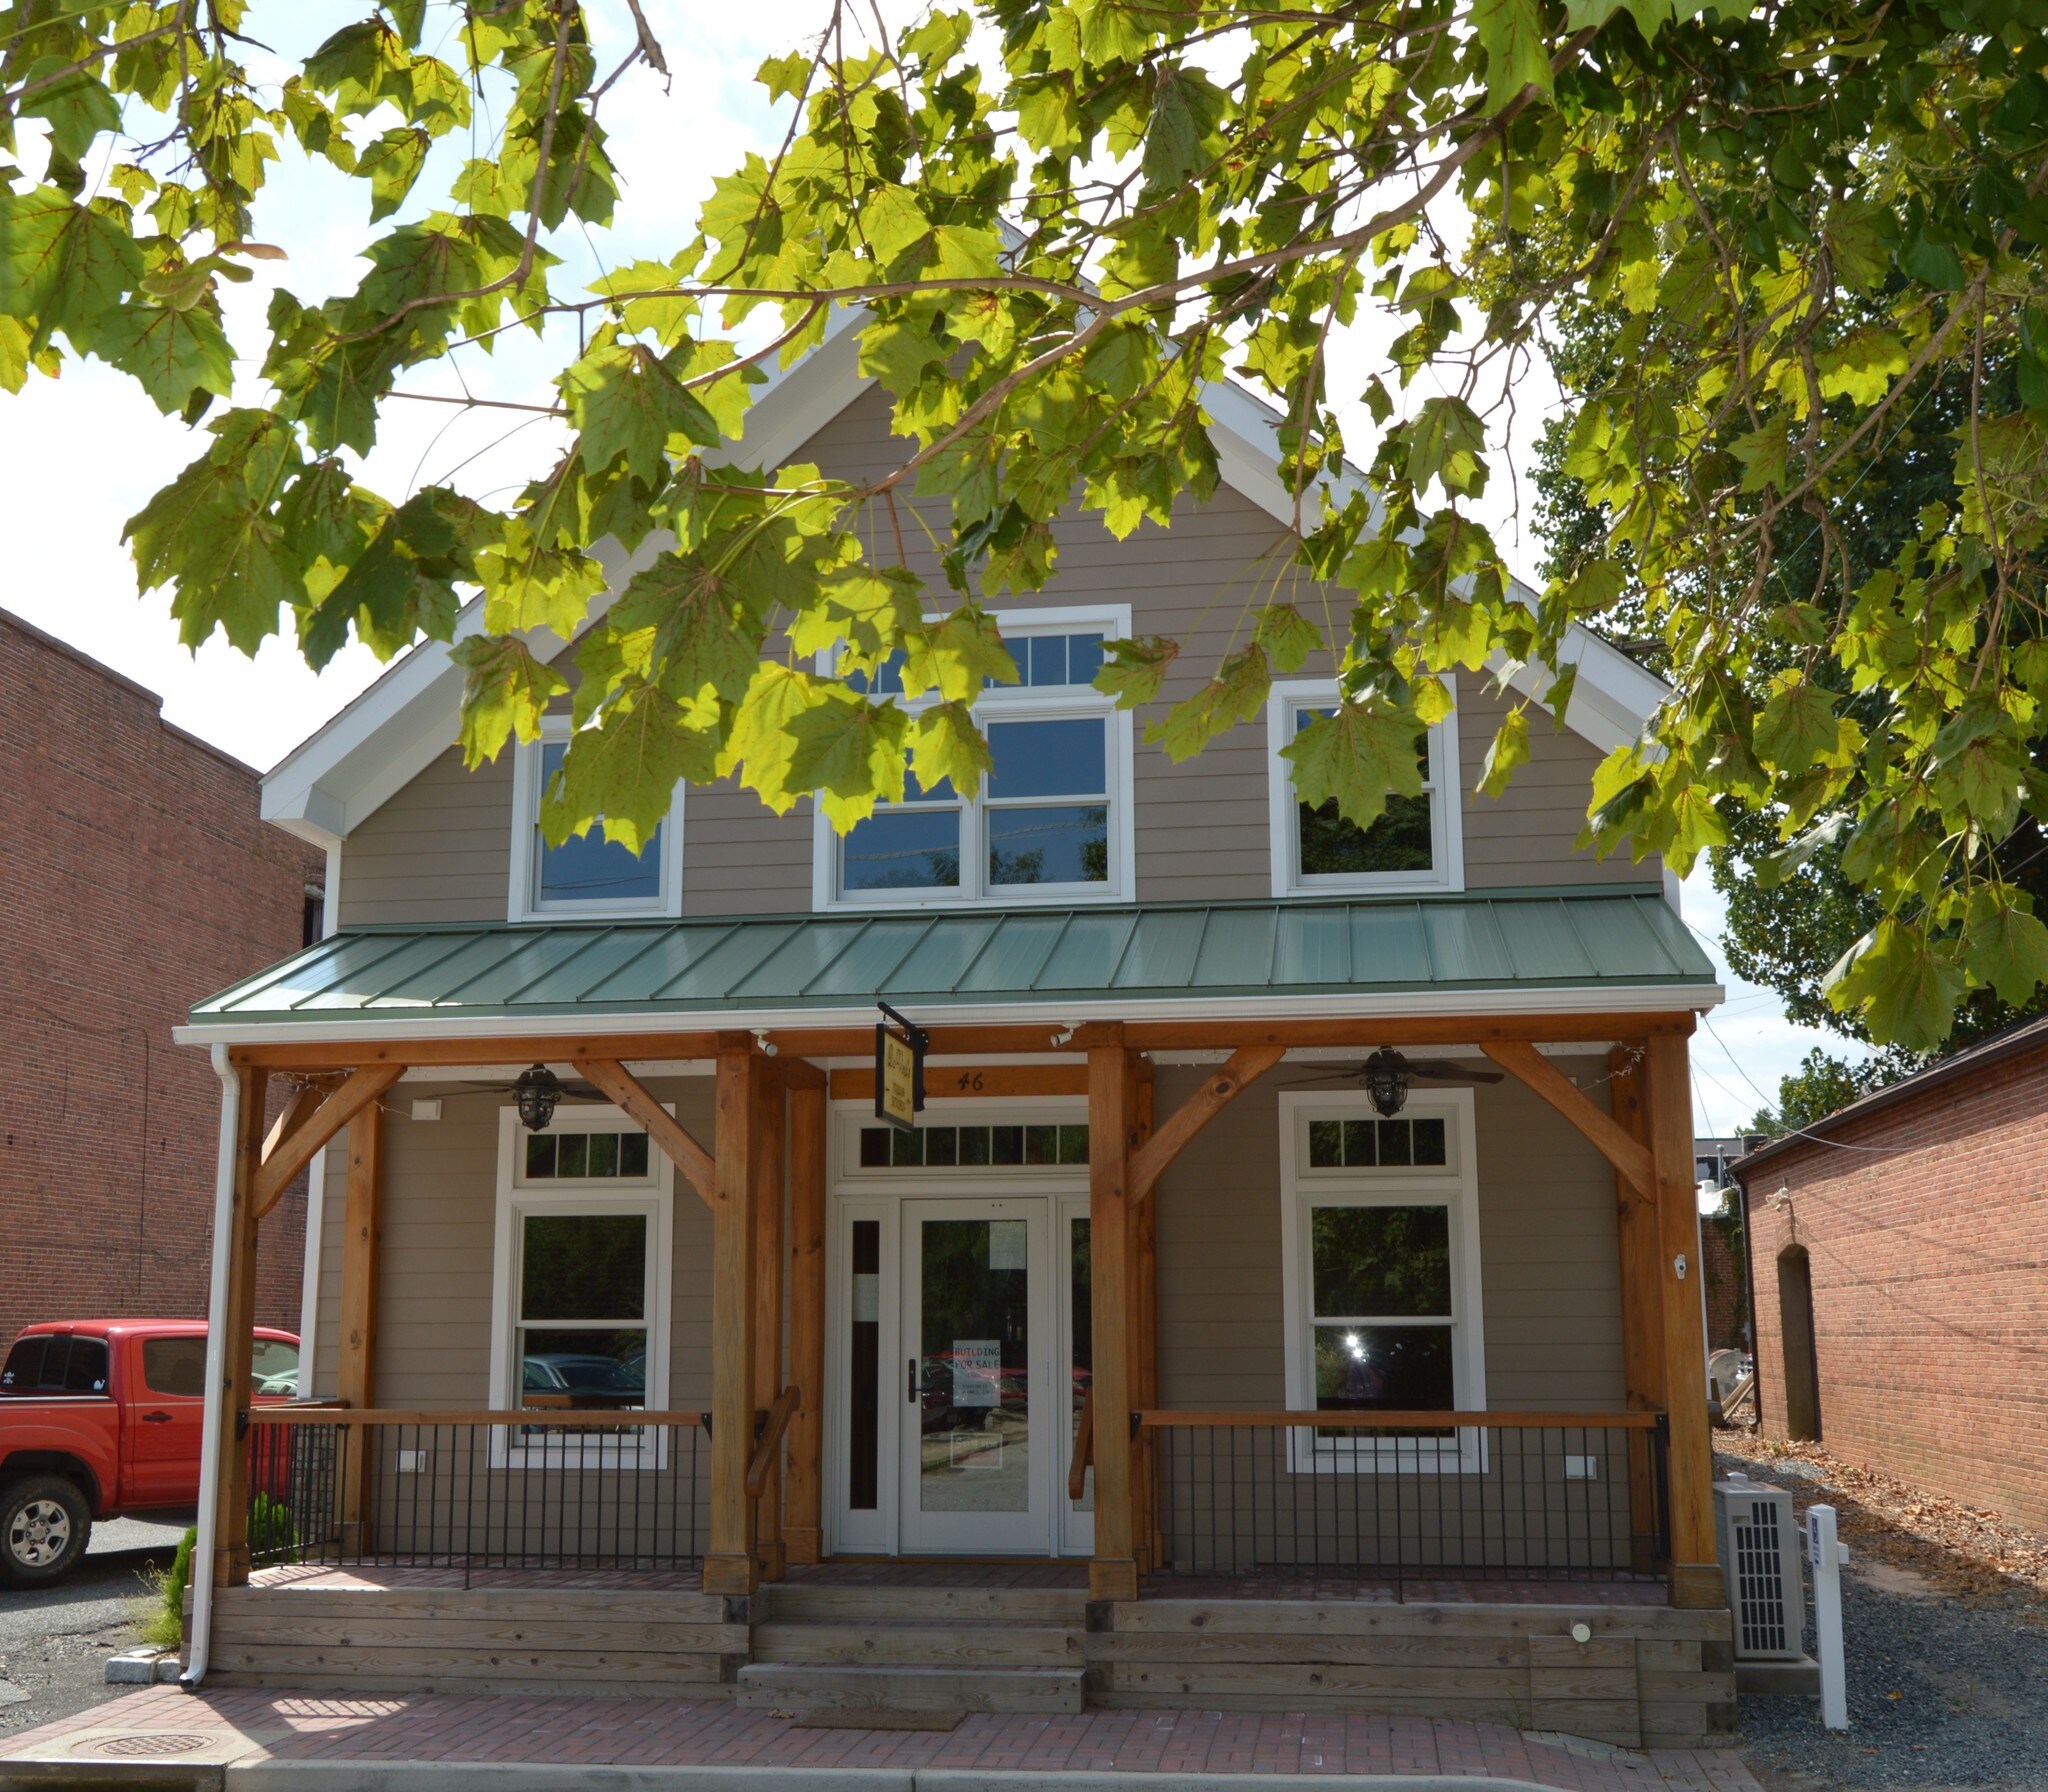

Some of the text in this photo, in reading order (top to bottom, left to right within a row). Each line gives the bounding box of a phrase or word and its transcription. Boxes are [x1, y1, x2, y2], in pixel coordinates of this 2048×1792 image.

[957, 1071, 984, 1092] 46
[954, 1347, 1000, 1357] BUILDING
[954, 1359, 1000, 1370] FOR SALE
